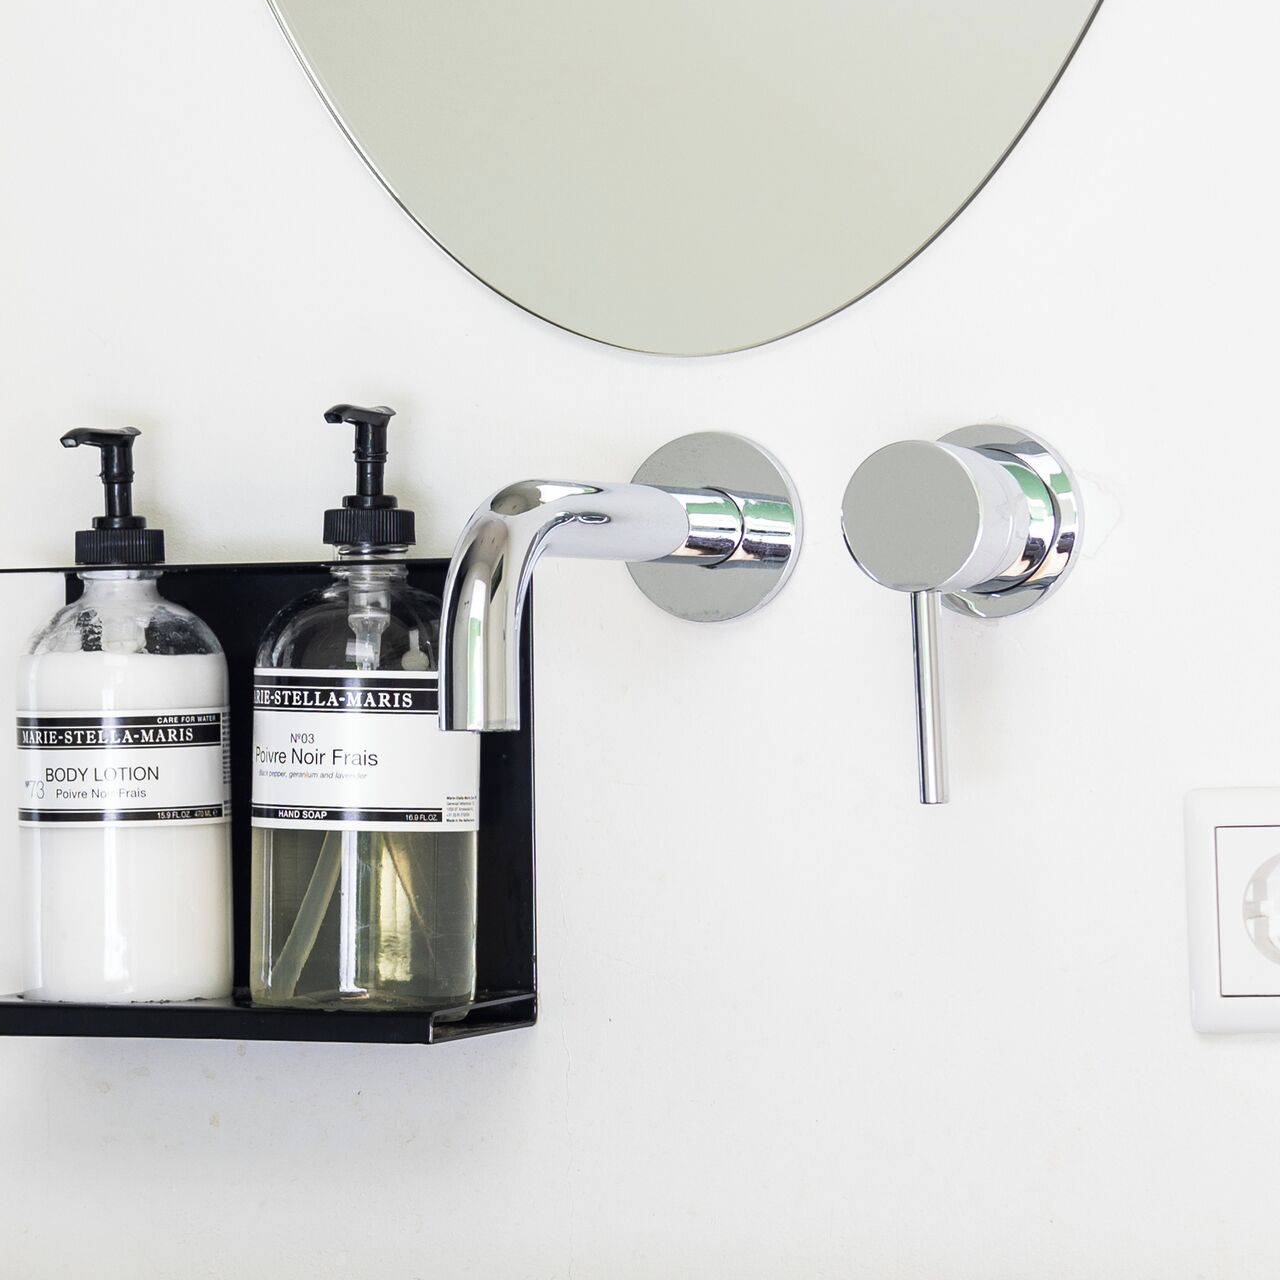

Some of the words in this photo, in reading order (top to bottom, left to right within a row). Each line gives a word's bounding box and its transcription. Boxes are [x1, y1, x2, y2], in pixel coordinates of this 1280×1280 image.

[157, 716, 179, 724] CARE
[181, 715, 196, 723] FOR
[197, 714, 216, 722] WATER
[22, 728, 194, 745] MARIE-STELLA-MARIS
[256, 746, 287, 764] Poivre
[291, 748, 326, 765] Noir
[332, 748, 379, 766] Frais
[45, 767, 89, 783] BODY
[94, 766, 159, 782] LOTION
[320, 771, 334, 779] and
[56, 788, 88, 799] Poivre
[119, 788, 147, 799] Frais
[278, 809, 300, 818] HAND
[302, 810, 328, 819] SOAP
